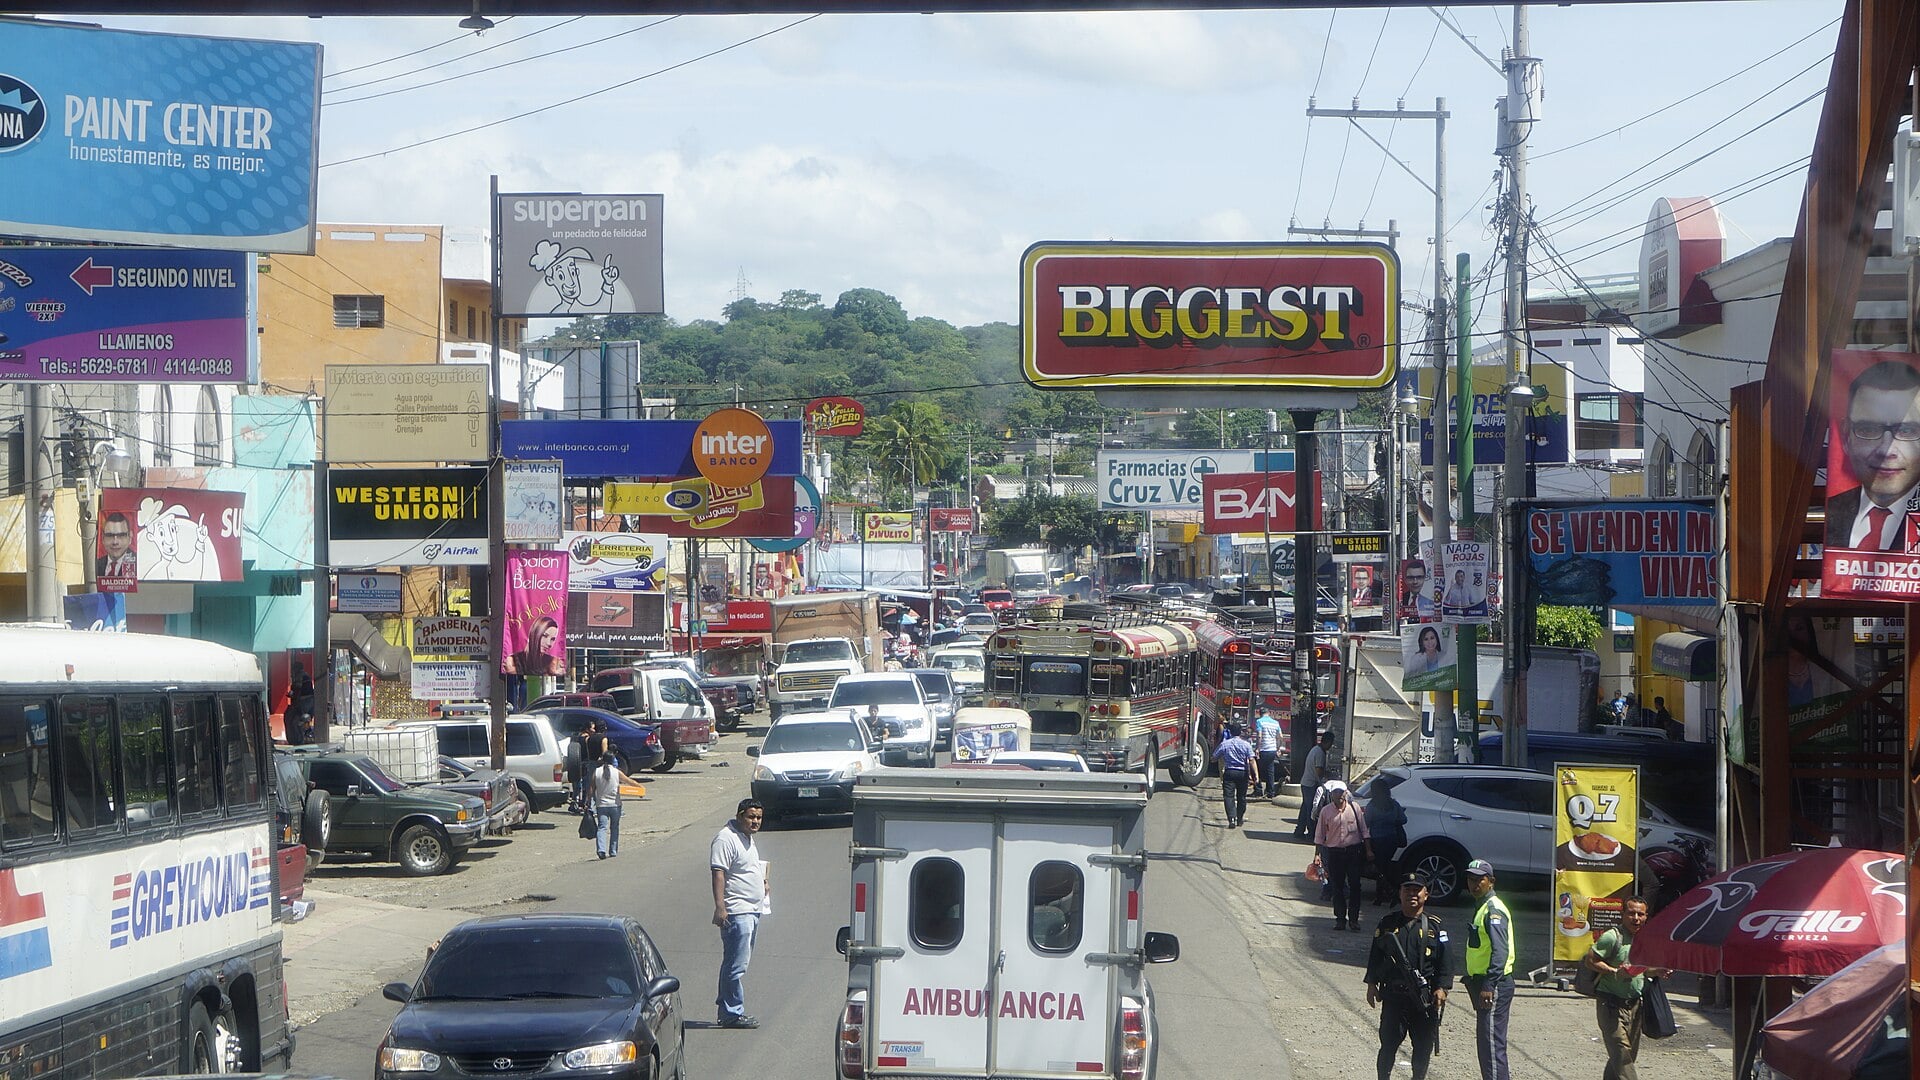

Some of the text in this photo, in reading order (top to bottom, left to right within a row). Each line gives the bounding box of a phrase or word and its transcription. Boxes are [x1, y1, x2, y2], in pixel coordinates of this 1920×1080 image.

[64, 95, 272, 150] PAINT CENTER
[70, 138, 265, 175] honestamente, es mejor.
[513, 199, 647, 228] superpan
[564, 229, 600, 240] pedacito
[601, 229, 611, 238] de
[613, 228, 647, 238] felicidad
[117, 267, 236, 288] SEGUNDO NIVEL
[25, 302, 66, 313] VIERNES
[1058, 285, 1360, 346] BIGGEST
[38, 312, 55, 321] 2X1
[98, 333, 174, 350] LLAMENOS
[39, 357, 232, 375] Tels.: 5629-6781 / 4114-0848
[329, 368, 484, 388] Invierta con seguridad
[414, 393, 433, 403] propia
[416, 404, 458, 413] Pavimentadas
[701, 431, 767, 455] inter
[504, 463, 561, 474] Pet-Wash
[709, 457, 758, 466] BANCO
[1108, 459, 1187, 477] Farmacias
[335, 486, 458, 503] WESTERN
[1108, 478, 1161, 503] Cruz
[374, 503, 458, 521] UNION
[1213, 488, 1296, 519] BAM
[220, 507, 242, 538] SU
[868, 530, 910, 538] PINULITO
[1334, 537, 1379, 545] WESTERN
[1531, 511, 1566, 555] SE
[1569, 510, 1681, 553] VENDEN
[443, 546, 480, 556] AirPak
[592, 544, 652, 552] FERRETERIA
[1275, 549, 1296, 563] 24
[1446, 543, 1480, 555] NAPO
[520, 552, 559, 569] Salón
[1452, 553, 1485, 562] ROJAS
[101, 577, 134, 586] BALDIZÓN
[513, 573, 563, 591] Belleza
[1852, 578, 1920, 594] PRESIDENTE
[422, 619, 480, 638] BARBERIA
[1862, 618, 1873, 627] en
[566, 631, 665, 643] ugar ideal para compartir
[1566, 793, 1620, 830] Q.7
[131, 851, 249, 941] GREYHOUND
[1738, 909, 1858, 939] Gallo
[1773, 934, 1829, 942] CERVEZA
[891, 1045, 922, 1053] TRANSAM
